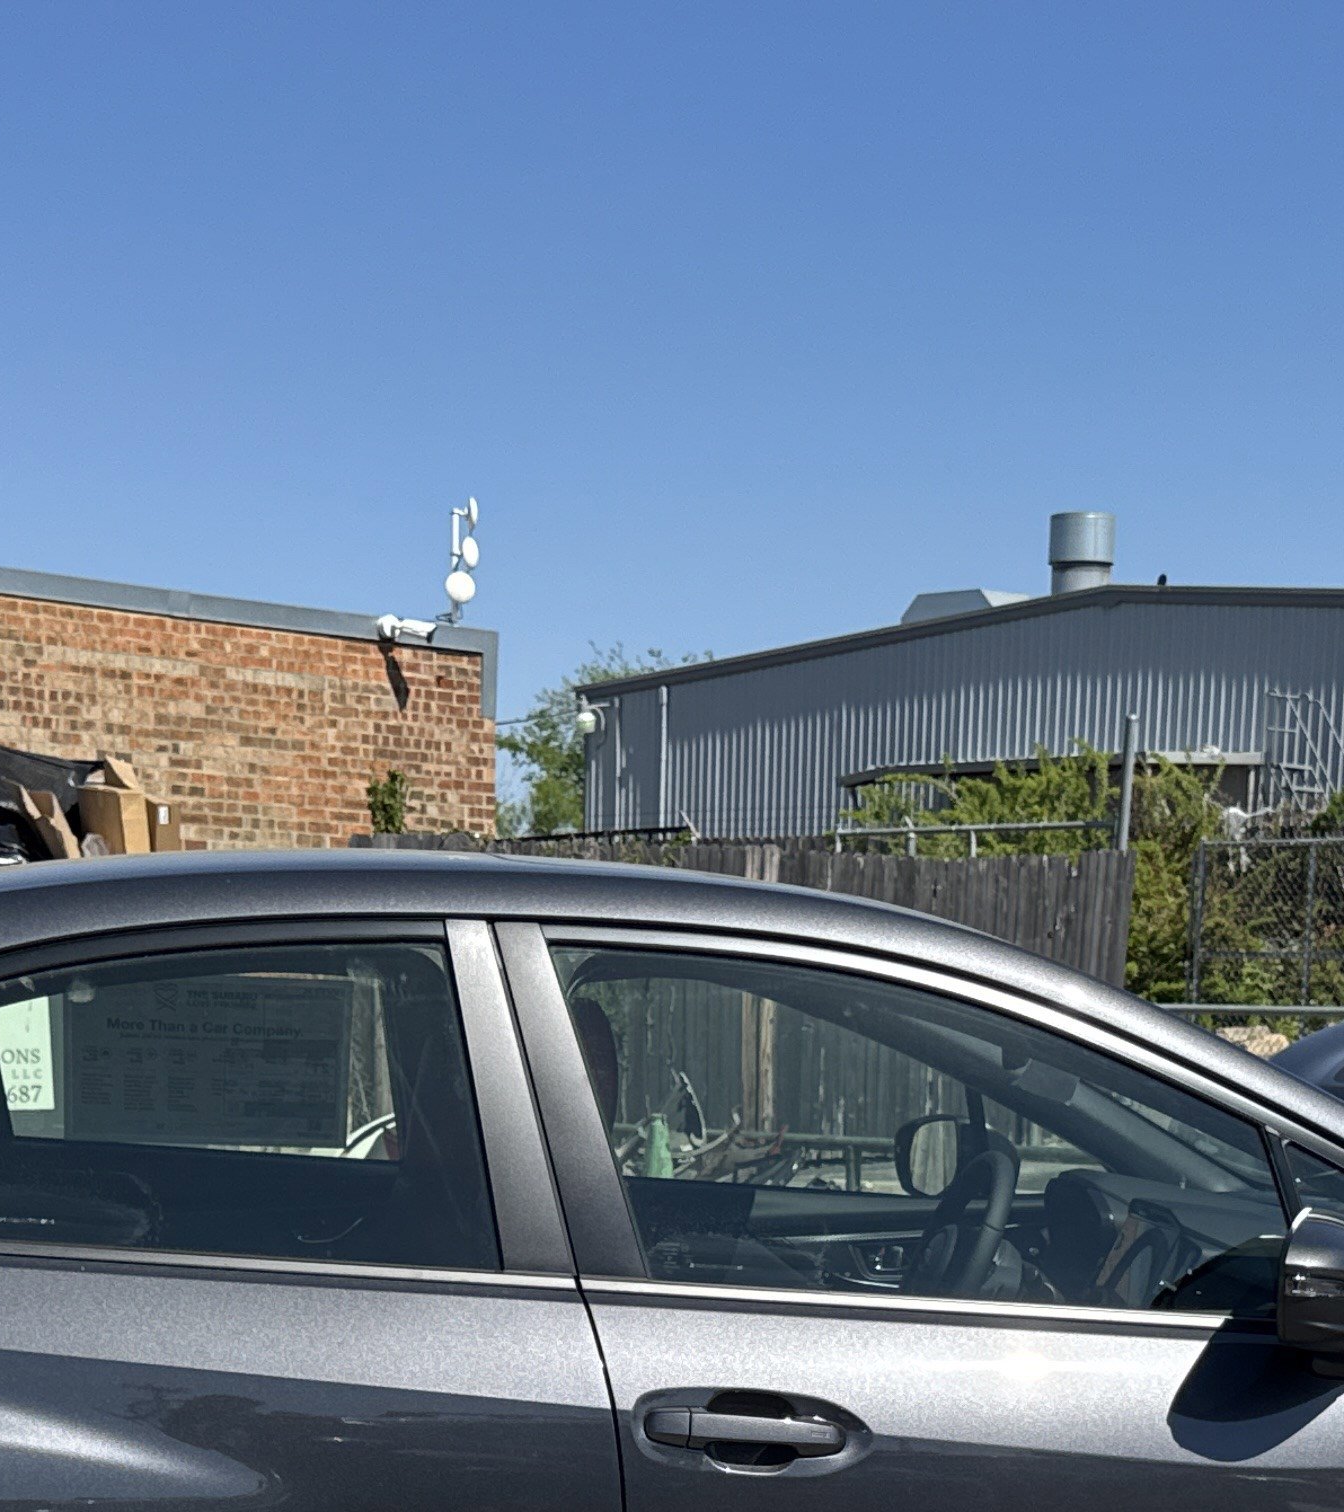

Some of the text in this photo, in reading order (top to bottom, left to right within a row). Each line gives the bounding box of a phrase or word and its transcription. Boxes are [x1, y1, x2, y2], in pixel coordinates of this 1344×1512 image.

[107, 1017, 145, 1031] More
[149, 1019, 185, 1033] Than
[189, 1023, 198, 1034] a
[202, 1022, 228, 1035] Car
[233, 1023, 304, 1039] Company.
[11, 1068, 43, 1080] LLC
